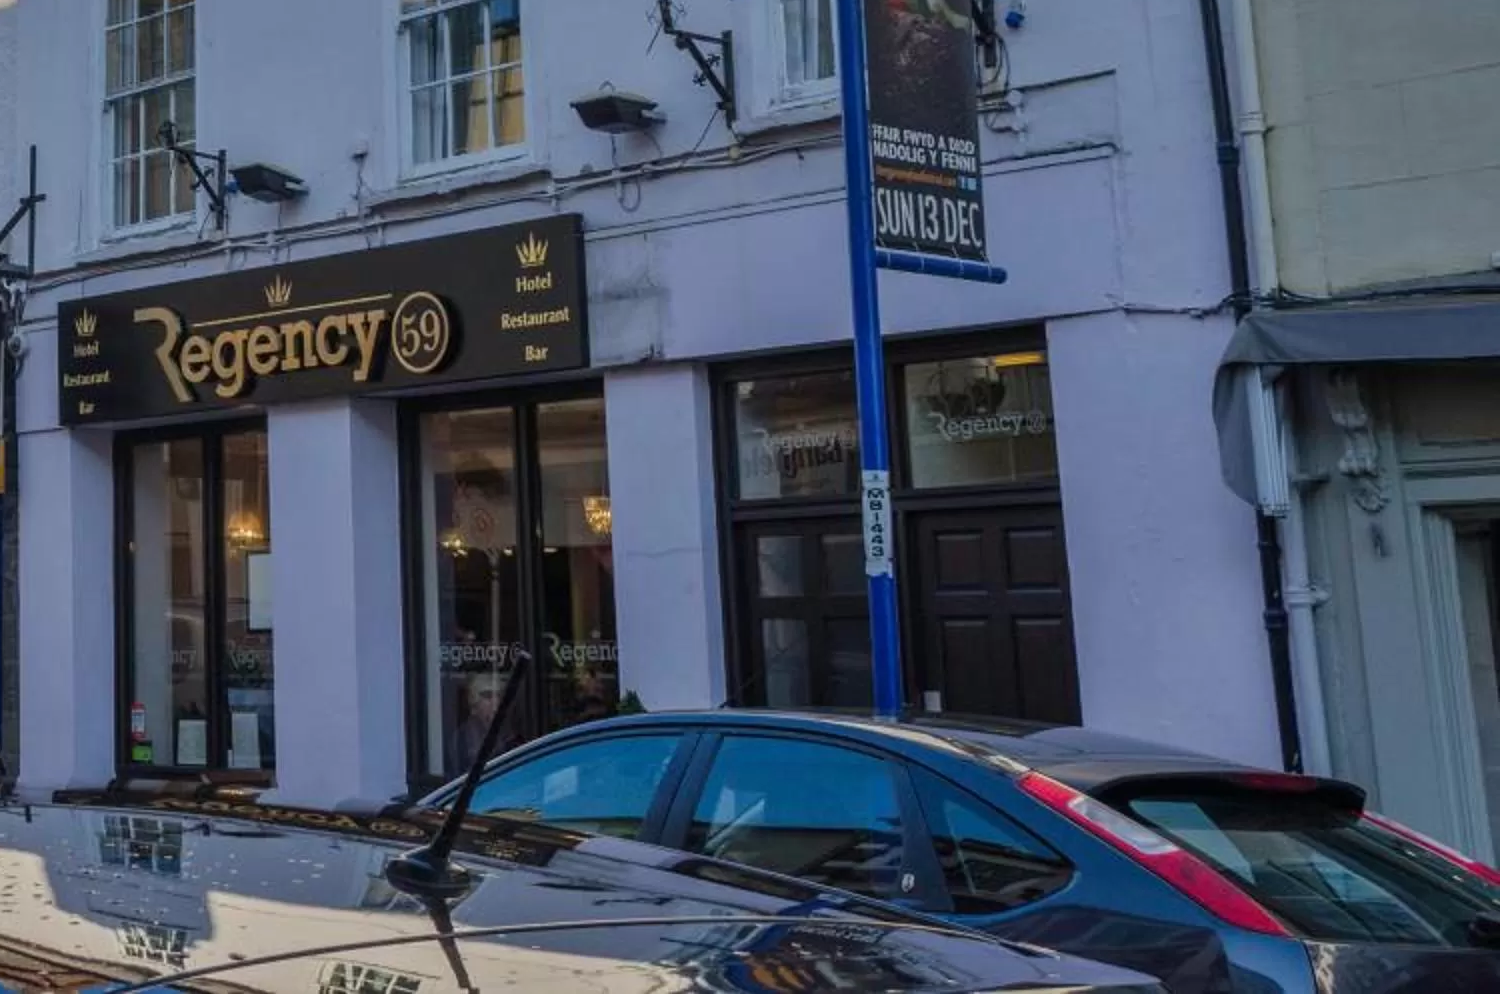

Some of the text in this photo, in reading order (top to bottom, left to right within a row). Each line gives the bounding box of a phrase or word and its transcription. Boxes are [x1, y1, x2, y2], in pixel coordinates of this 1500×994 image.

[877, 186, 983, 248] SUN 13 DEC
[515, 271, 552, 294] Hotel
[501, 306, 571, 330] Restaurant
[133, 306, 443, 403] Regency 59
[524, 344, 550, 362] Bar
[63, 370, 111, 389] Restaurant
[928, 410, 1024, 442] Regency
